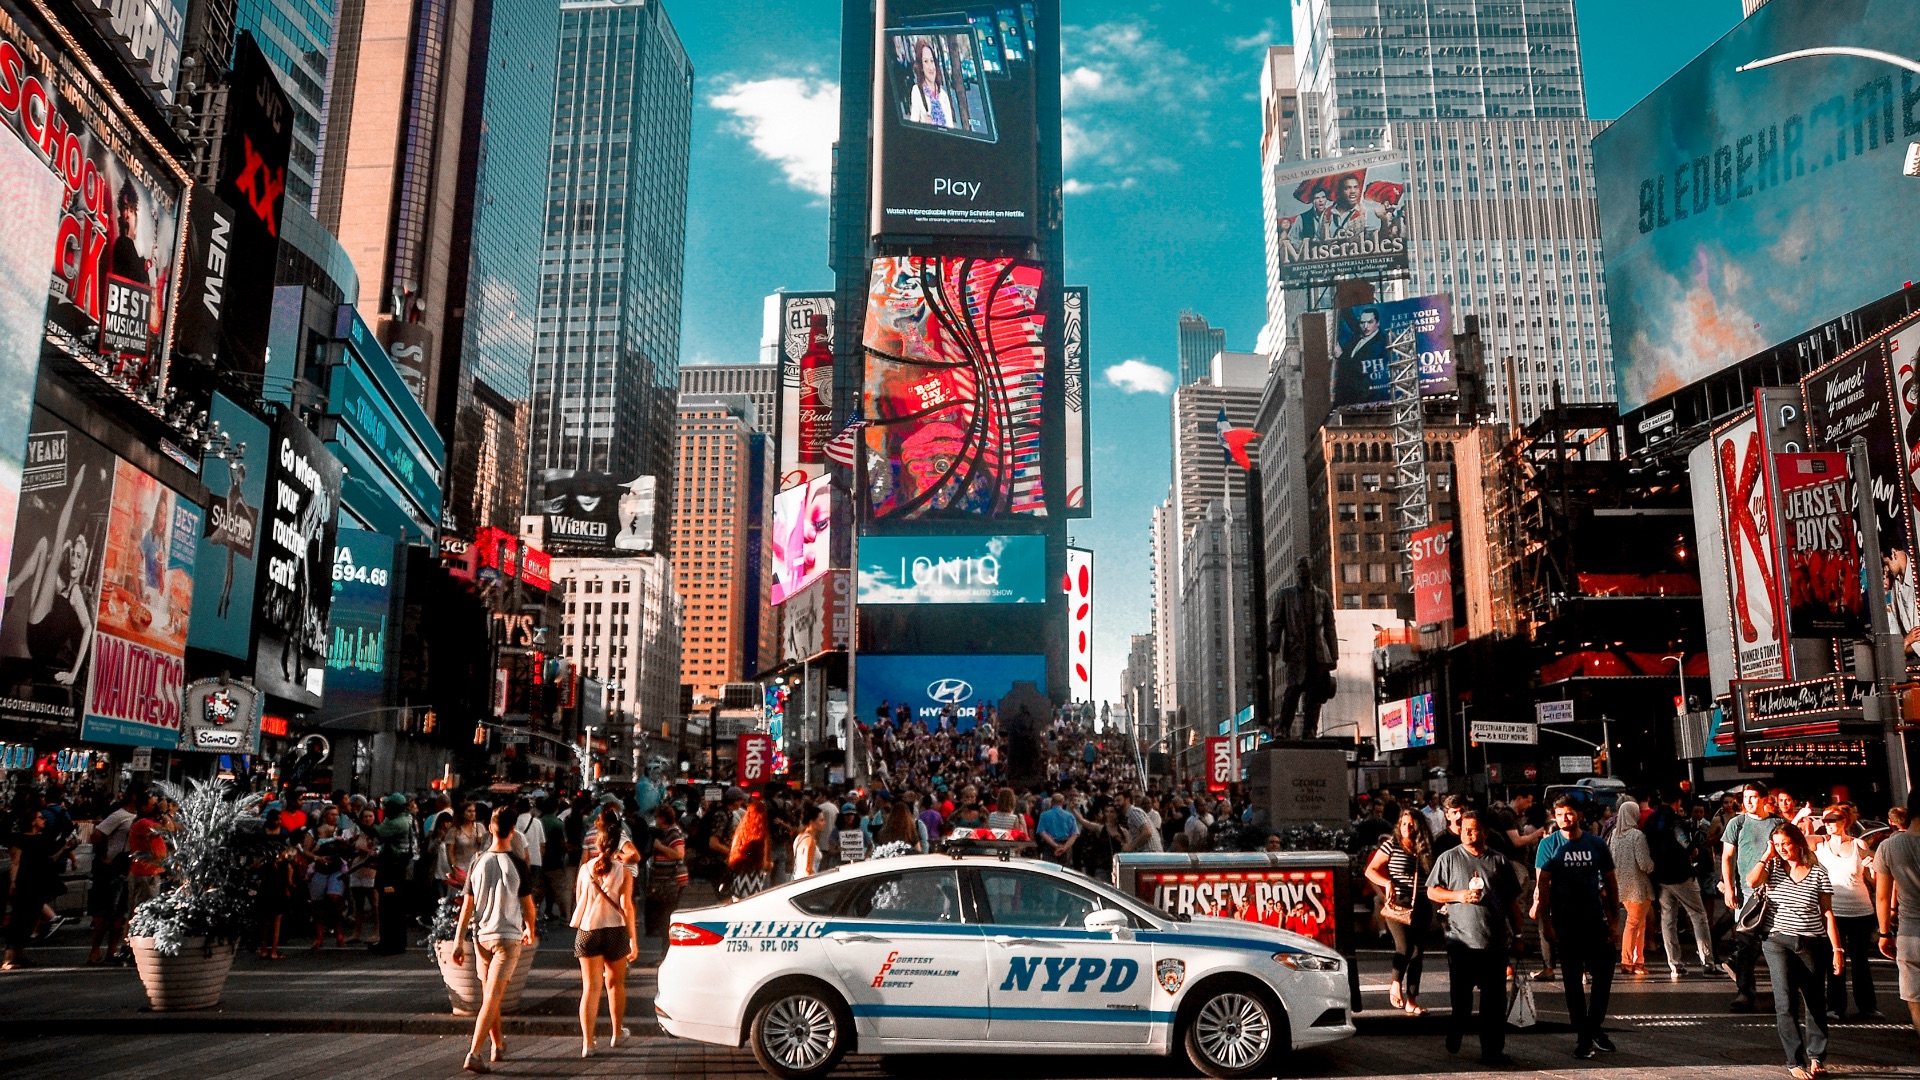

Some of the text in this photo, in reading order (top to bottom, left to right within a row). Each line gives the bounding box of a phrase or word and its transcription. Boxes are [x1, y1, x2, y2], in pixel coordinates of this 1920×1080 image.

[91, 0, 179, 106] URPLE
[59, 51, 88, 92] ANDREW
[40, 51, 58, 87] THE
[60, 73, 112, 145] EMPOWERING
[111, 133, 143, 182] MESSAGE
[256, 75, 283, 134] JVC
[1277, 173, 1299, 183] FINAL
[1301, 165, 1335, 178] MONTHS
[934, 178, 981, 201] Play
[886, 207, 907, 215] Watch
[908, 207, 947, 216] Unbreakable
[947, 209, 969, 218] Kimmy
[969, 209, 995, 217] Schmidt
[1005, 210, 1025, 218] Netflix
[1325, 220, 1354, 240] Les
[203, 211, 231, 320] NEW
[107, 283, 149, 319] BEST
[1392, 309, 1439, 320] LET YOUR
[105, 314, 148, 339] MUSICAL!
[921, 387, 941, 401] day
[1825, 360, 1867, 402] Winner!
[1828, 389, 1865, 418] 4 TONY AWARDS
[1824, 419, 1845, 443] Best
[1845, 401, 1880, 430] Musical!
[29, 439, 65, 462] YEARS
[281, 437, 322, 496] Go where
[277, 480, 300, 514] your
[1785, 481, 1848, 520] JERSEY
[176, 505, 199, 536] BEST
[1795, 516, 1843, 552] BOYS
[272, 517, 306, 559] routine
[269, 556, 296, 592] can't.
[901, 556, 999, 586] IONIQ
[972, 588, 991, 597] AUTO
[991, 588, 1013, 597] SHOW
[1762, 658, 1775, 667] BEST
[92, 634, 183, 729] WAITRESS
[199, 732, 237, 745] Sanrio
[1474, 723, 1528, 733] PEDESTRIAN FLOW ZONE
[1511, 733, 1528, 741] MOVING
[745, 737, 767, 780] tkts
[1291, 779, 1327, 788] GEORGE
[1563, 851, 1592, 862] ANU
[1255, 882, 1326, 924] BOYS
[724, 921, 827, 938] TRAFFIC
[760, 940, 777, 952] SPL
[781, 940, 799, 952] OPS
[886, 951, 934, 964] COURTESY
[871, 976, 914, 989] RESPECT
[879, 963, 960, 977] PROFESSIONALISM
[999, 956, 1139, 993] NYPD
